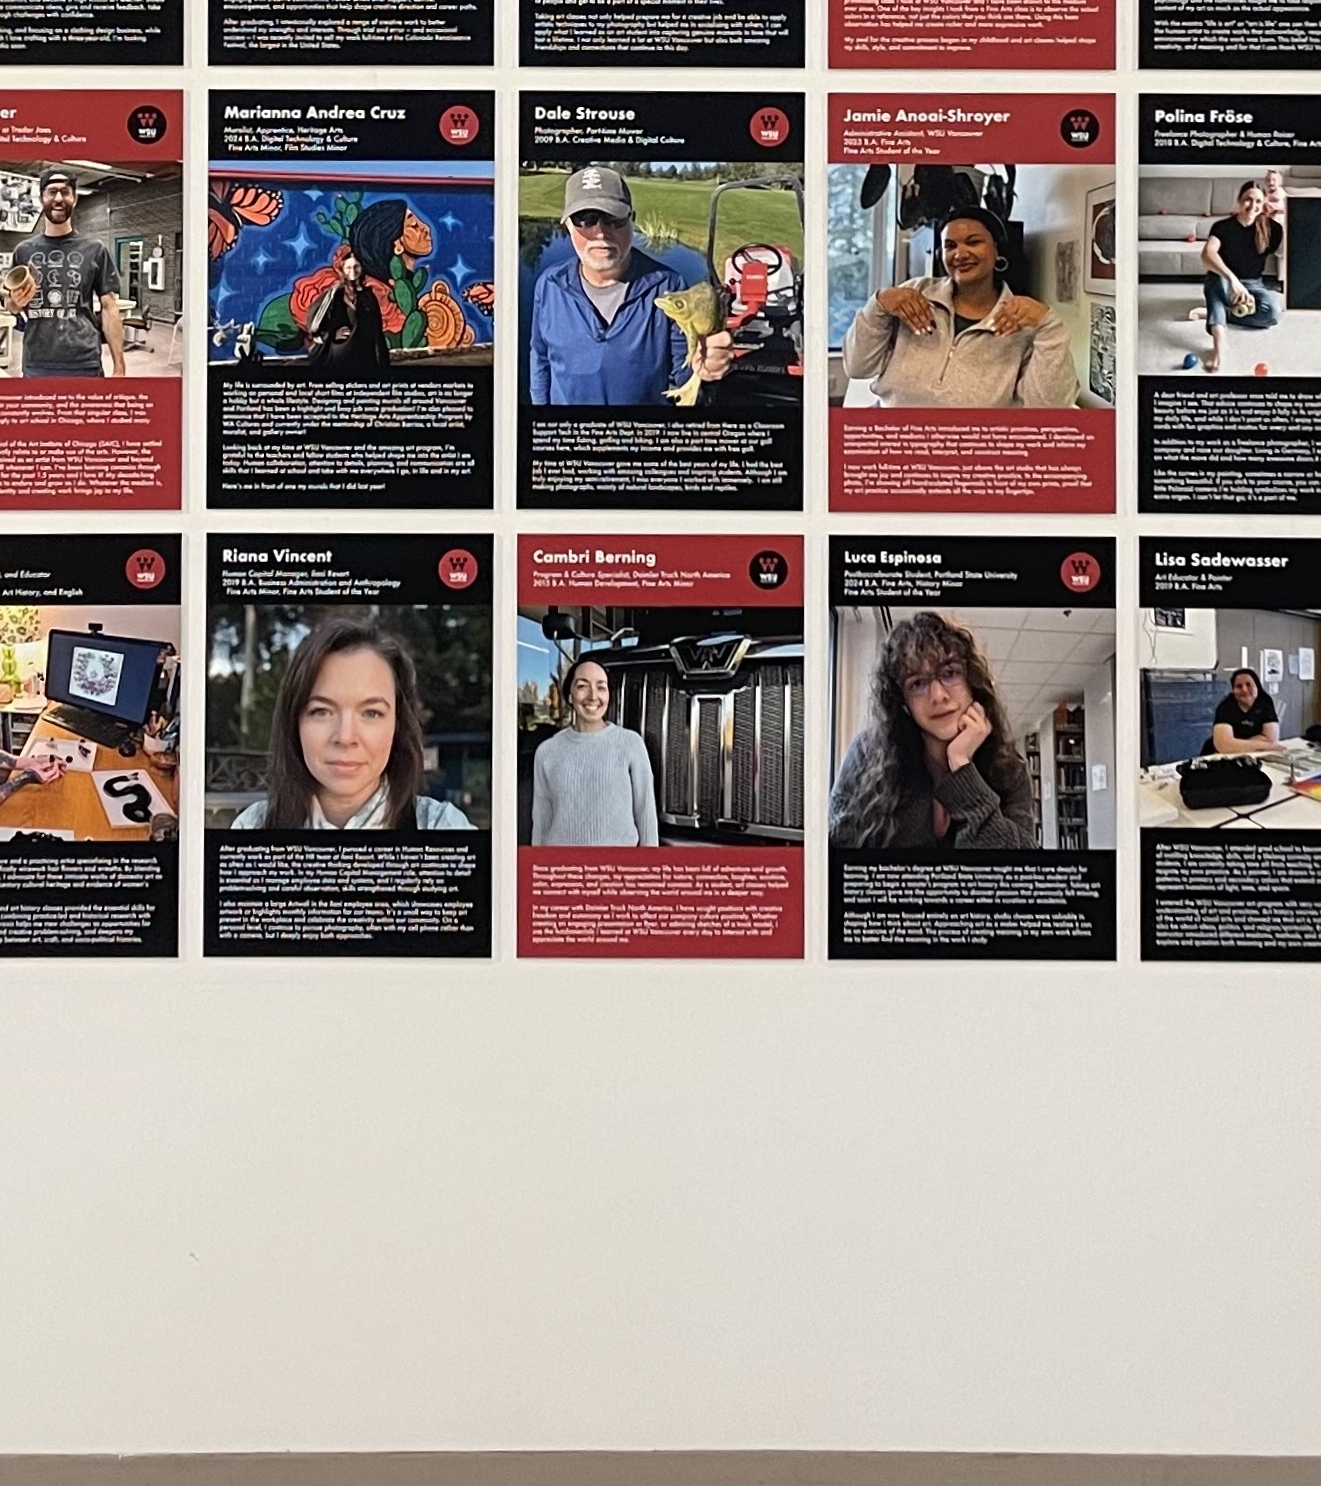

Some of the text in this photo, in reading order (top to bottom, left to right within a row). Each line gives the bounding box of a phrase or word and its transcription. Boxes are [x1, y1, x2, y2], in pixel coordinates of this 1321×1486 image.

[224, 105, 405, 119] Marianna Andrea Cruz
[535, 106, 635, 120] Dale Strouse
[844, 109, 1010, 125] Jamie Anoai-Shroyer
[1155, 109, 1253, 123] Polina Fröse
[223, 549, 332, 562] Riana Vincent
[534, 549, 655, 567] Cambri Berning
[845, 551, 941, 566] Luca Espinosa
[1156, 552, 1288, 567] Lisa Sadewasser
